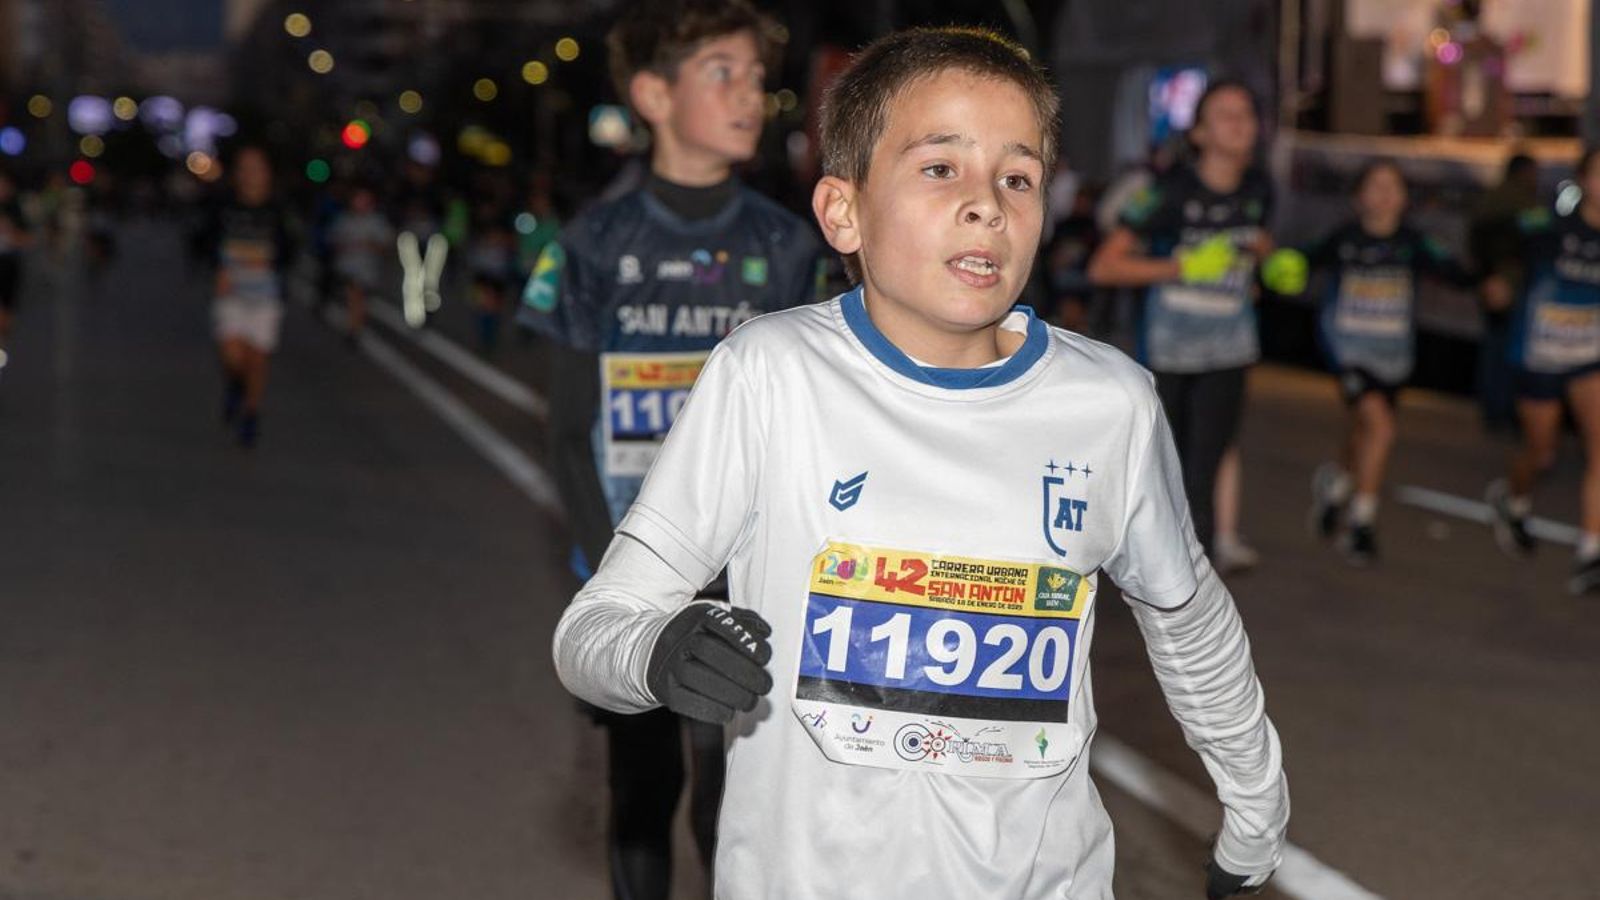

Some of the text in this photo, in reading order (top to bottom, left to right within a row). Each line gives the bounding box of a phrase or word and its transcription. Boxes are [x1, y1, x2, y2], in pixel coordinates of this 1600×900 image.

[617, 304, 668, 335] SAN
[875, 557, 928, 596] 42
[931, 571, 992, 582] INTERNACIONAL
[994, 576, 1016, 584] NOCHE
[932, 560, 1028, 578] CARRERA URBANA
[928, 580, 965, 599] SAN
[813, 606, 1069, 692] 11920
